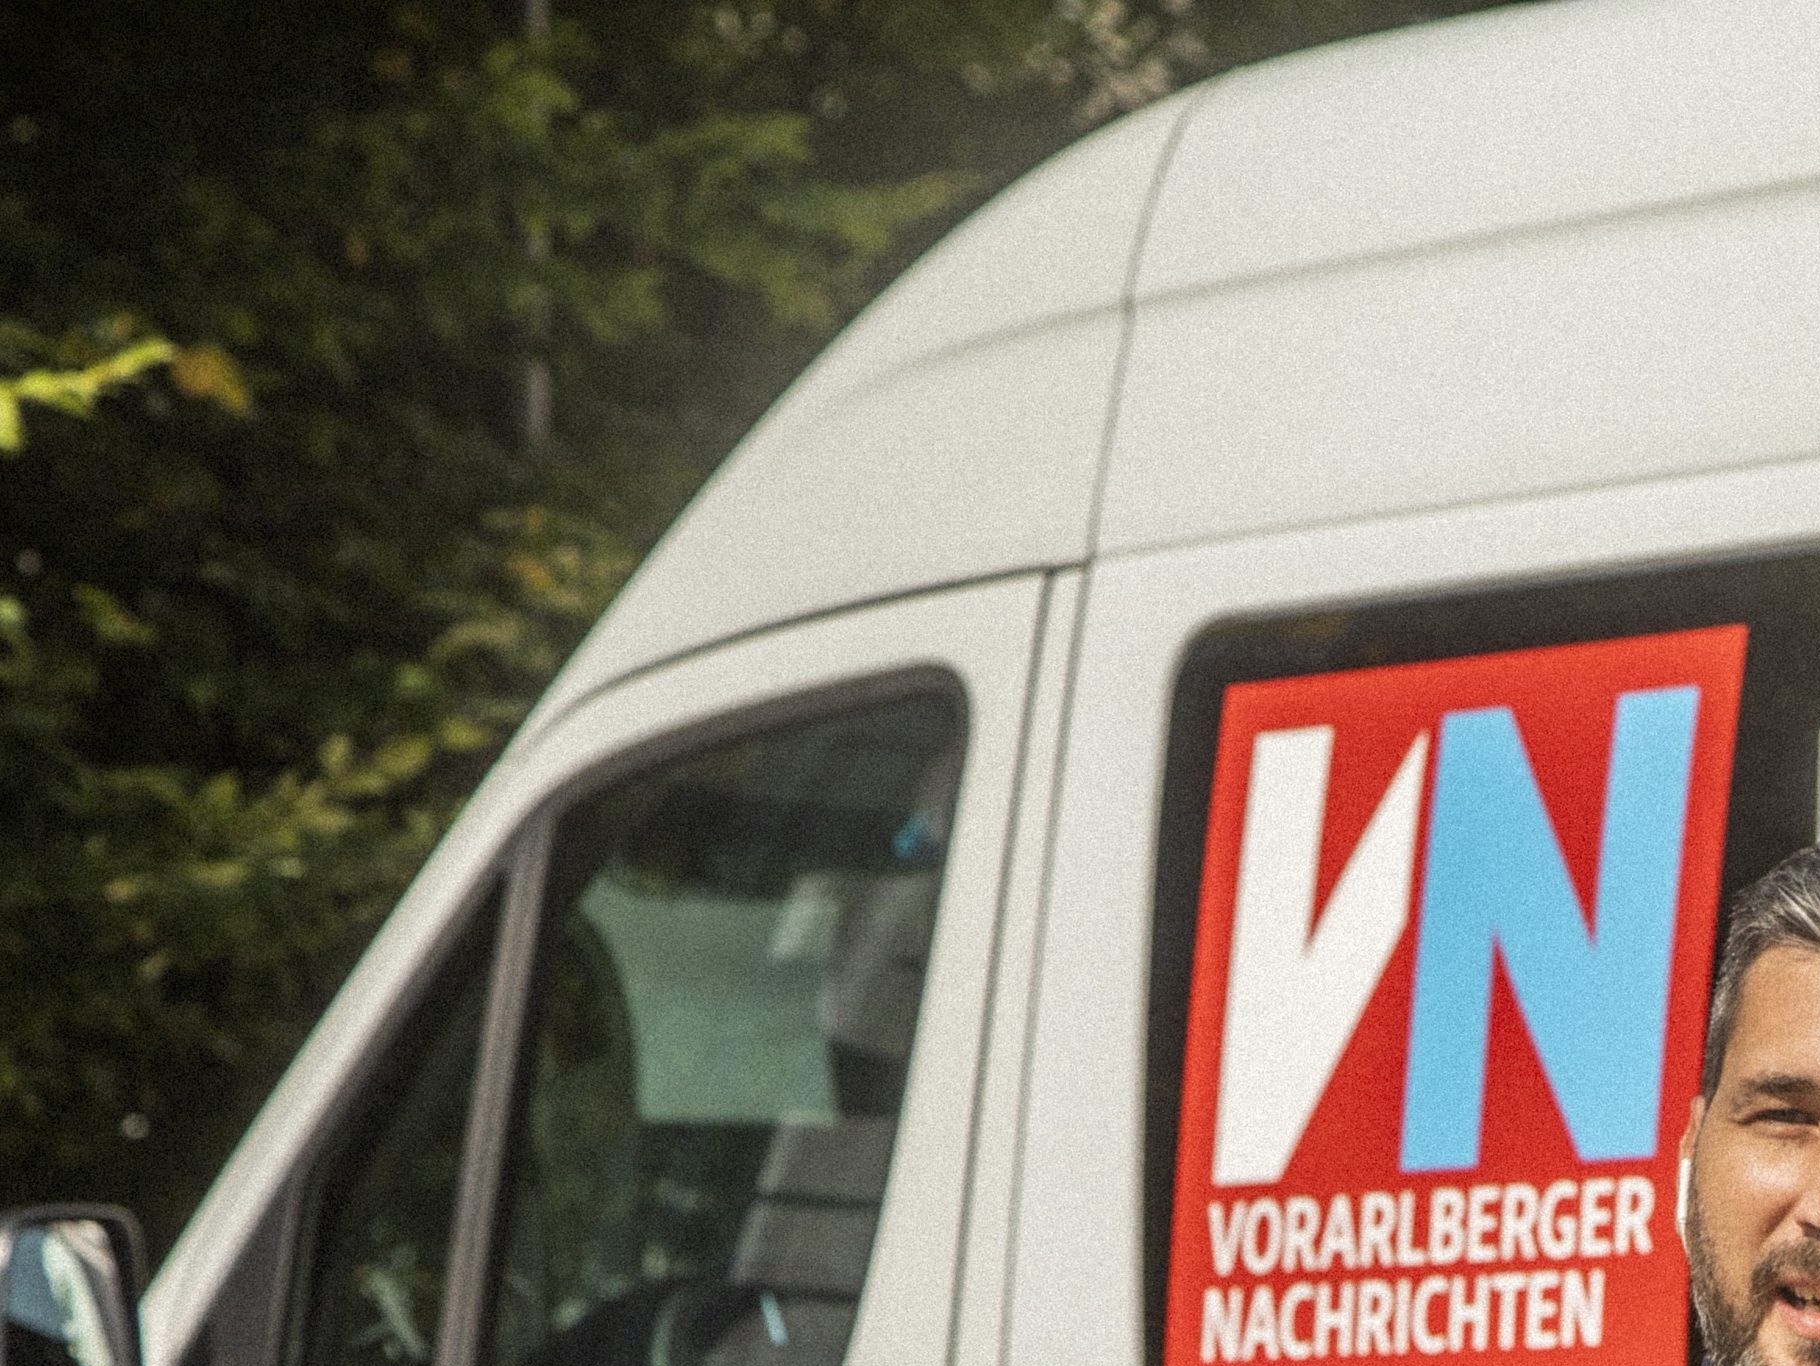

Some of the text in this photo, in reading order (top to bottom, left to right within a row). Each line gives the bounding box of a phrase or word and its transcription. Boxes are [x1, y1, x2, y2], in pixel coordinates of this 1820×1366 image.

[1211, 685, 1700, 1187] VN
[1208, 1176, 1655, 1277] VORARLBERGER
[1202, 1269, 1606, 1363] NACHRICHTEN
